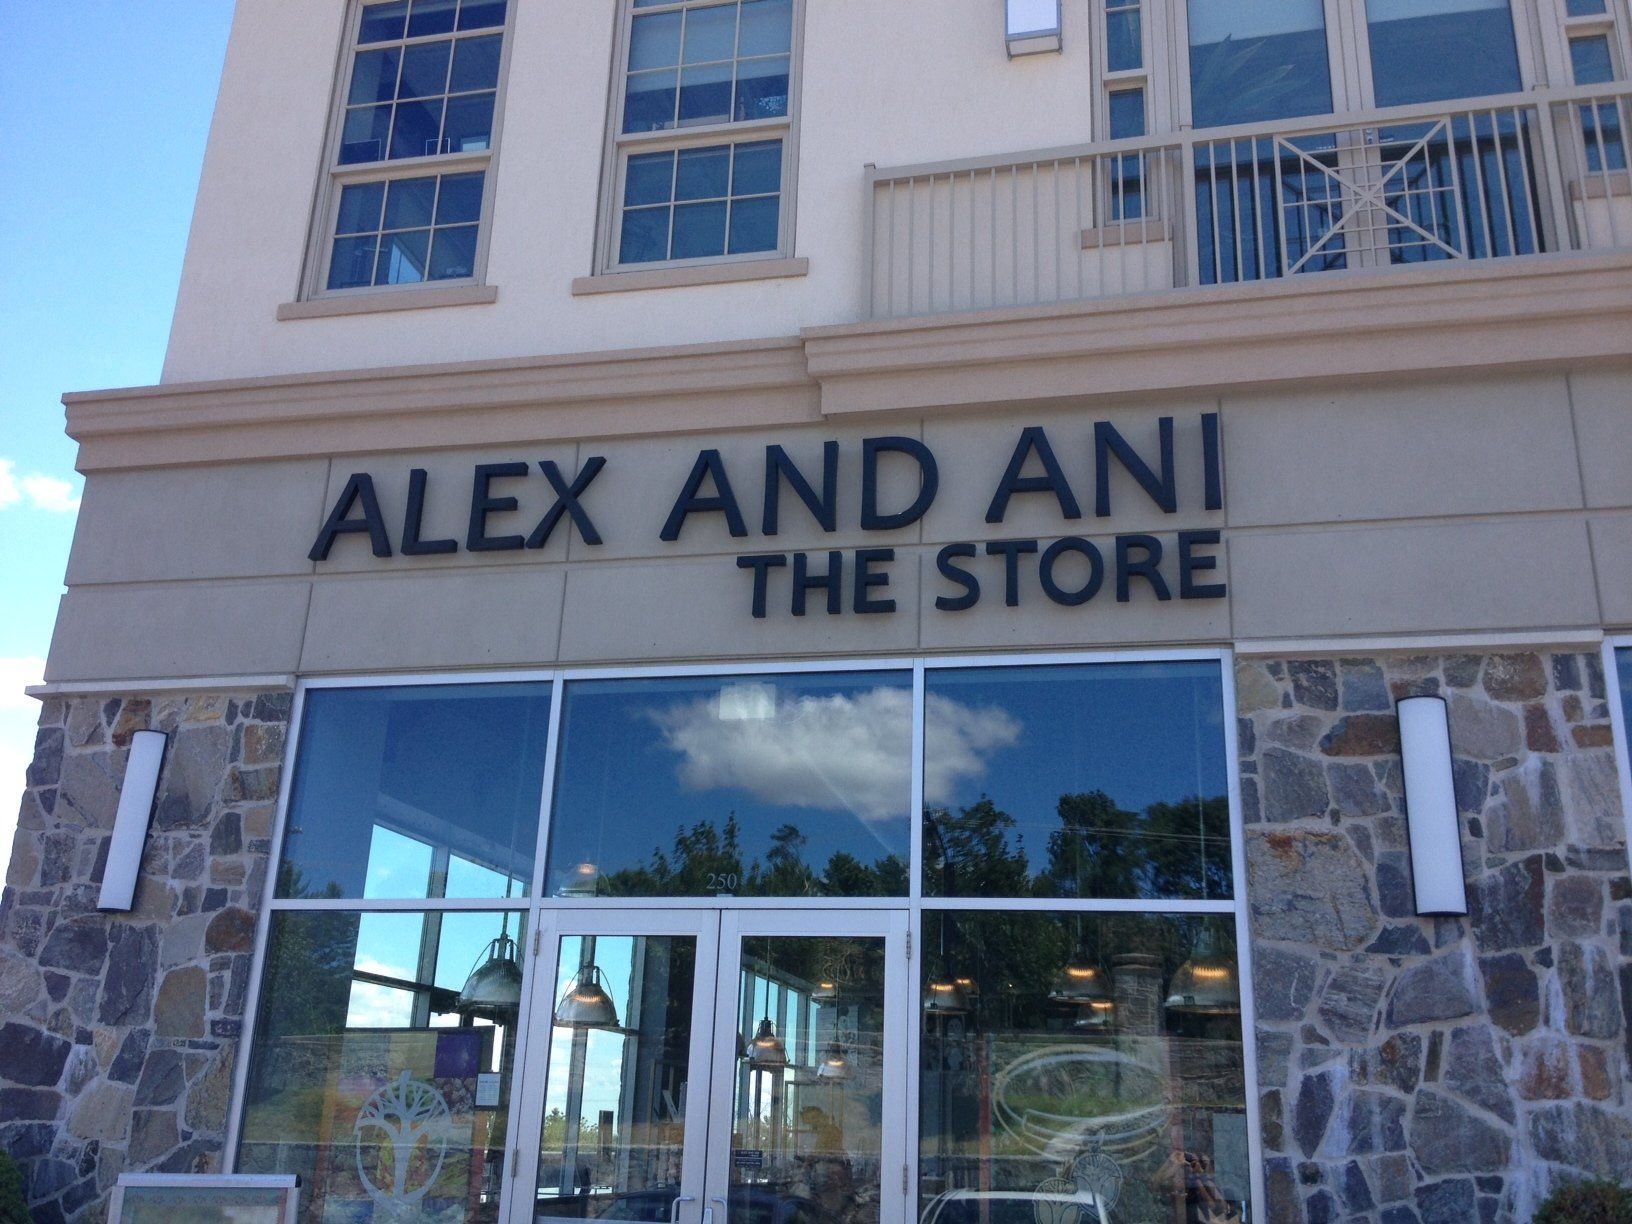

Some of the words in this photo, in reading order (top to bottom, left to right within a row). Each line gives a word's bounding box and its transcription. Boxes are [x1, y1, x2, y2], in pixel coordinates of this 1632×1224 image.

[308, 456, 608, 562] ALEX
[658, 436, 940, 545] AND
[984, 412, 1224, 525] ANI
[735, 547, 897, 620] THE
[935, 529, 1229, 612] STORE
[706, 873, 738, 890] 250
